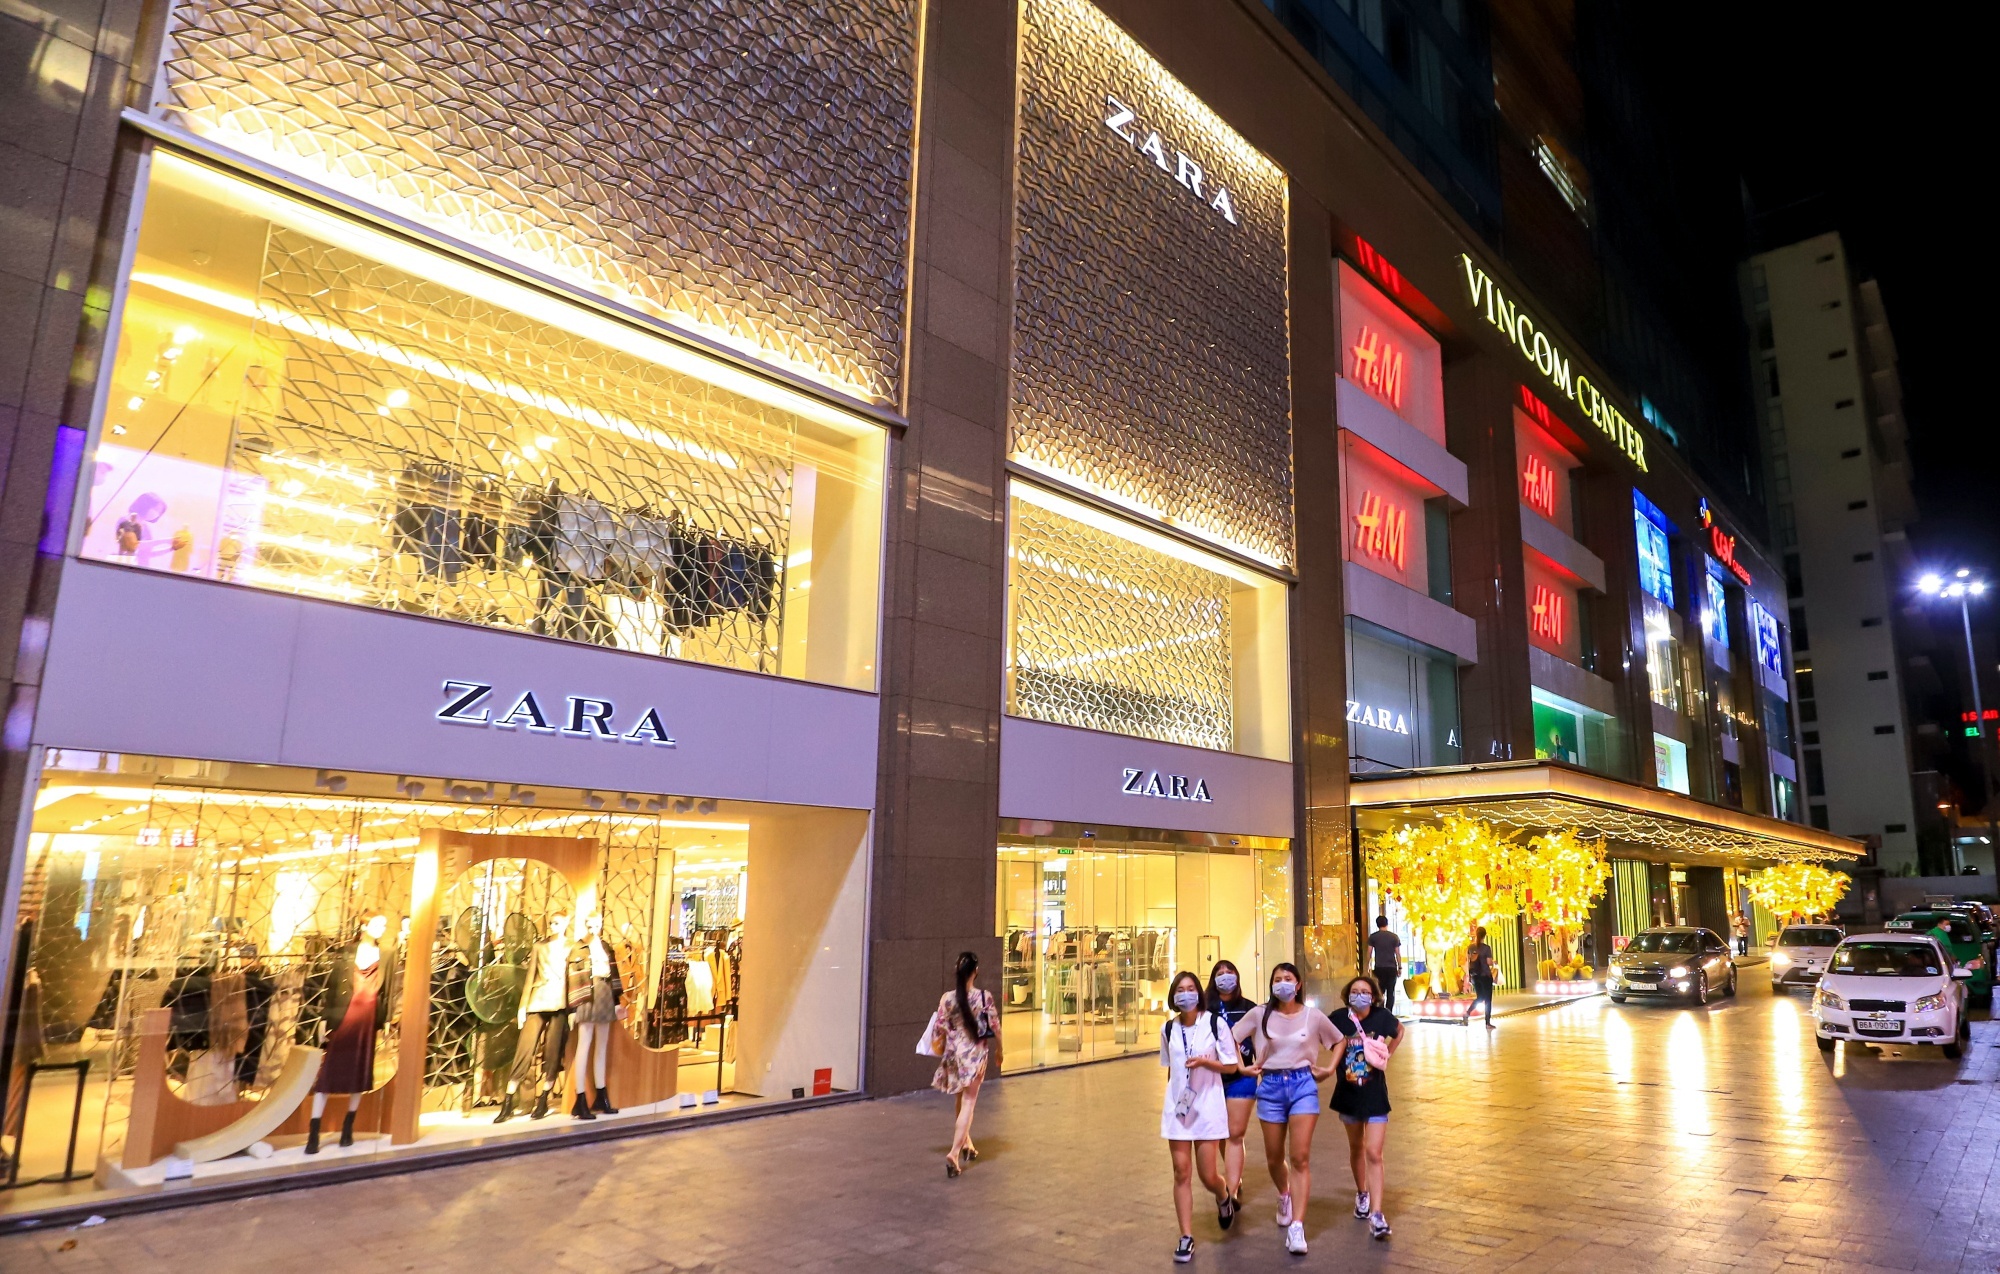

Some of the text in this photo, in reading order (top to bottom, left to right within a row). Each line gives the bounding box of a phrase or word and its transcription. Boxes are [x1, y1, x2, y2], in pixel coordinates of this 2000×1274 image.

[1104, 94, 1238, 226] ZARA
[1353, 325, 1403, 409] H&M
[1461, 252, 1649, 474] VINCOM CENTER
[1523, 454, 1553, 517] H&M
[1356, 489, 1406, 571] H&M
[1712, 526, 1734, 567] CGV
[1532, 584, 1562, 645] H&M
[436, 679, 678, 748] ZARA
[1345, 699, 1409, 735] ZARA
[1968, 709, 1999, 722] SAR
[1122, 767, 1214, 803] ZARA
